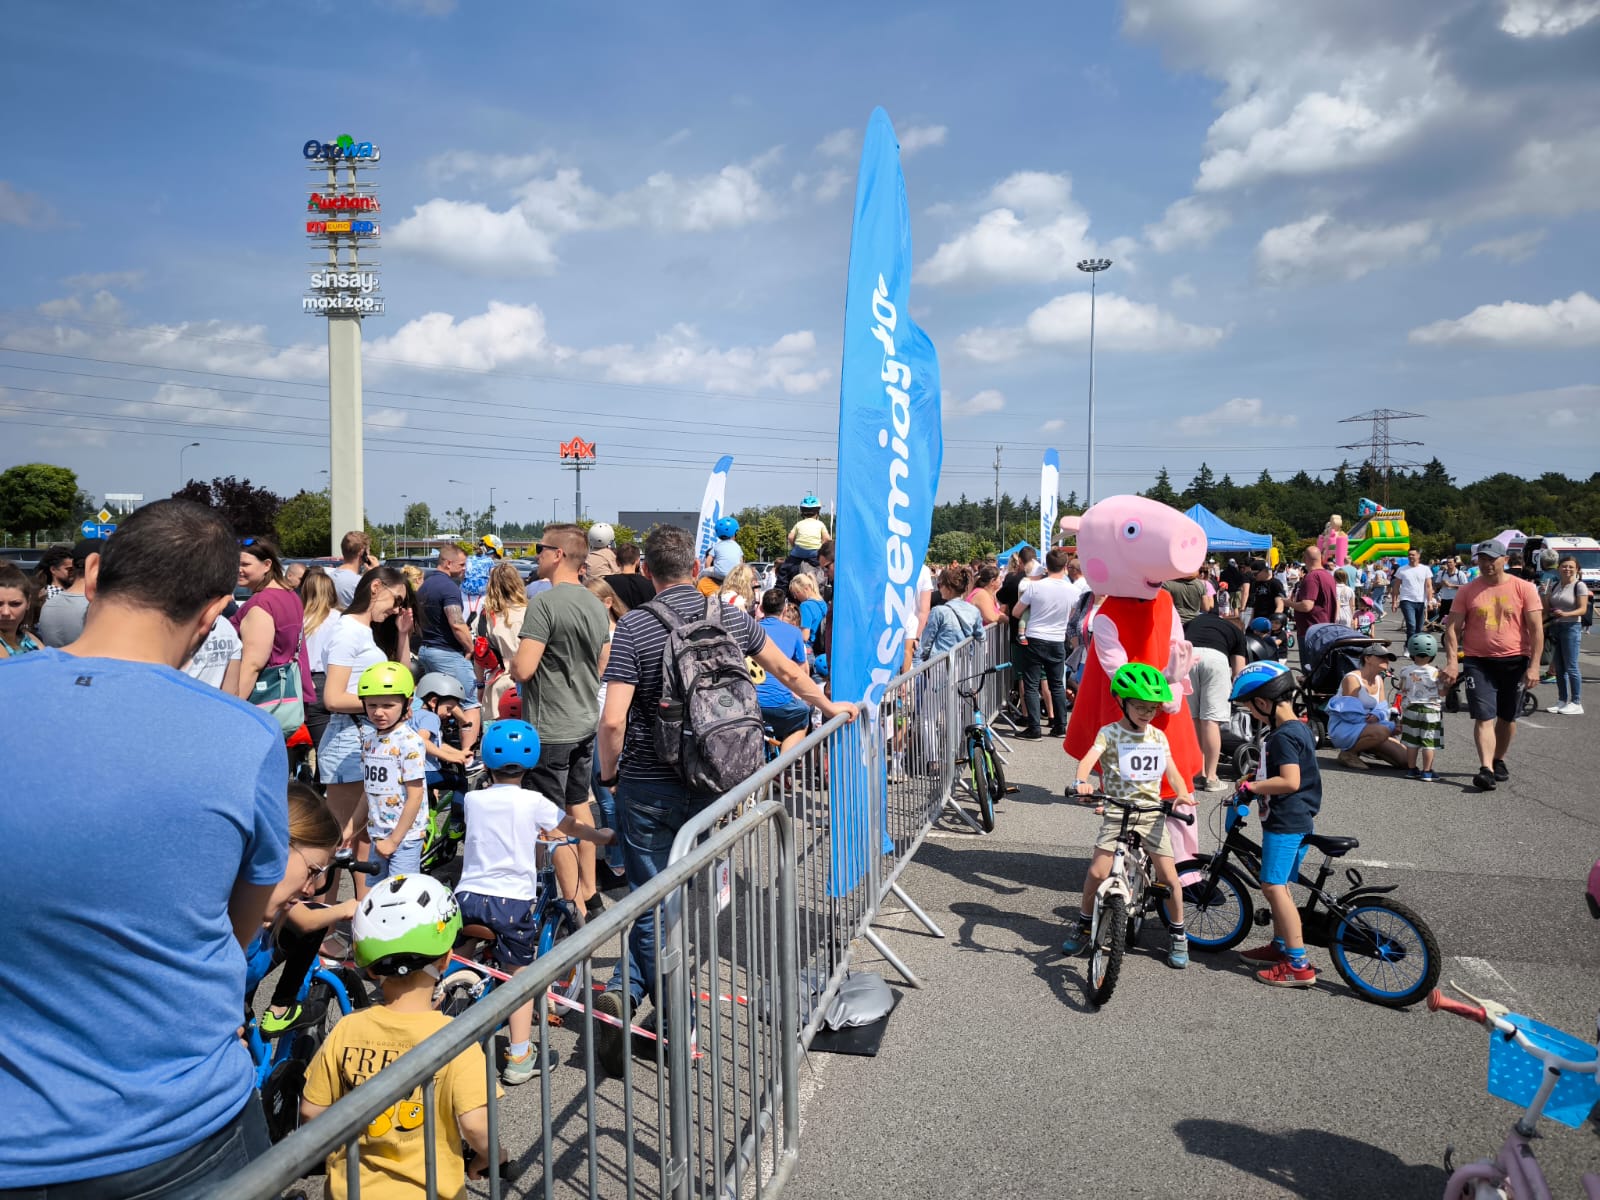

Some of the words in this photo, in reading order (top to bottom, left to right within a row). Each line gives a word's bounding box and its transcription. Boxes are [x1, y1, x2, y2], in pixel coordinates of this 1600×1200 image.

[308, 193, 371, 209] Auchan
[311, 269, 373, 293] sinsay
[303, 293, 342, 308] maxi
[345, 296, 374, 308] zoo
[560, 436, 595, 458] MAX
[1130, 755, 1159, 771] 021
[364, 764, 388, 782] 068
[341, 1046, 400, 1073] FRE
